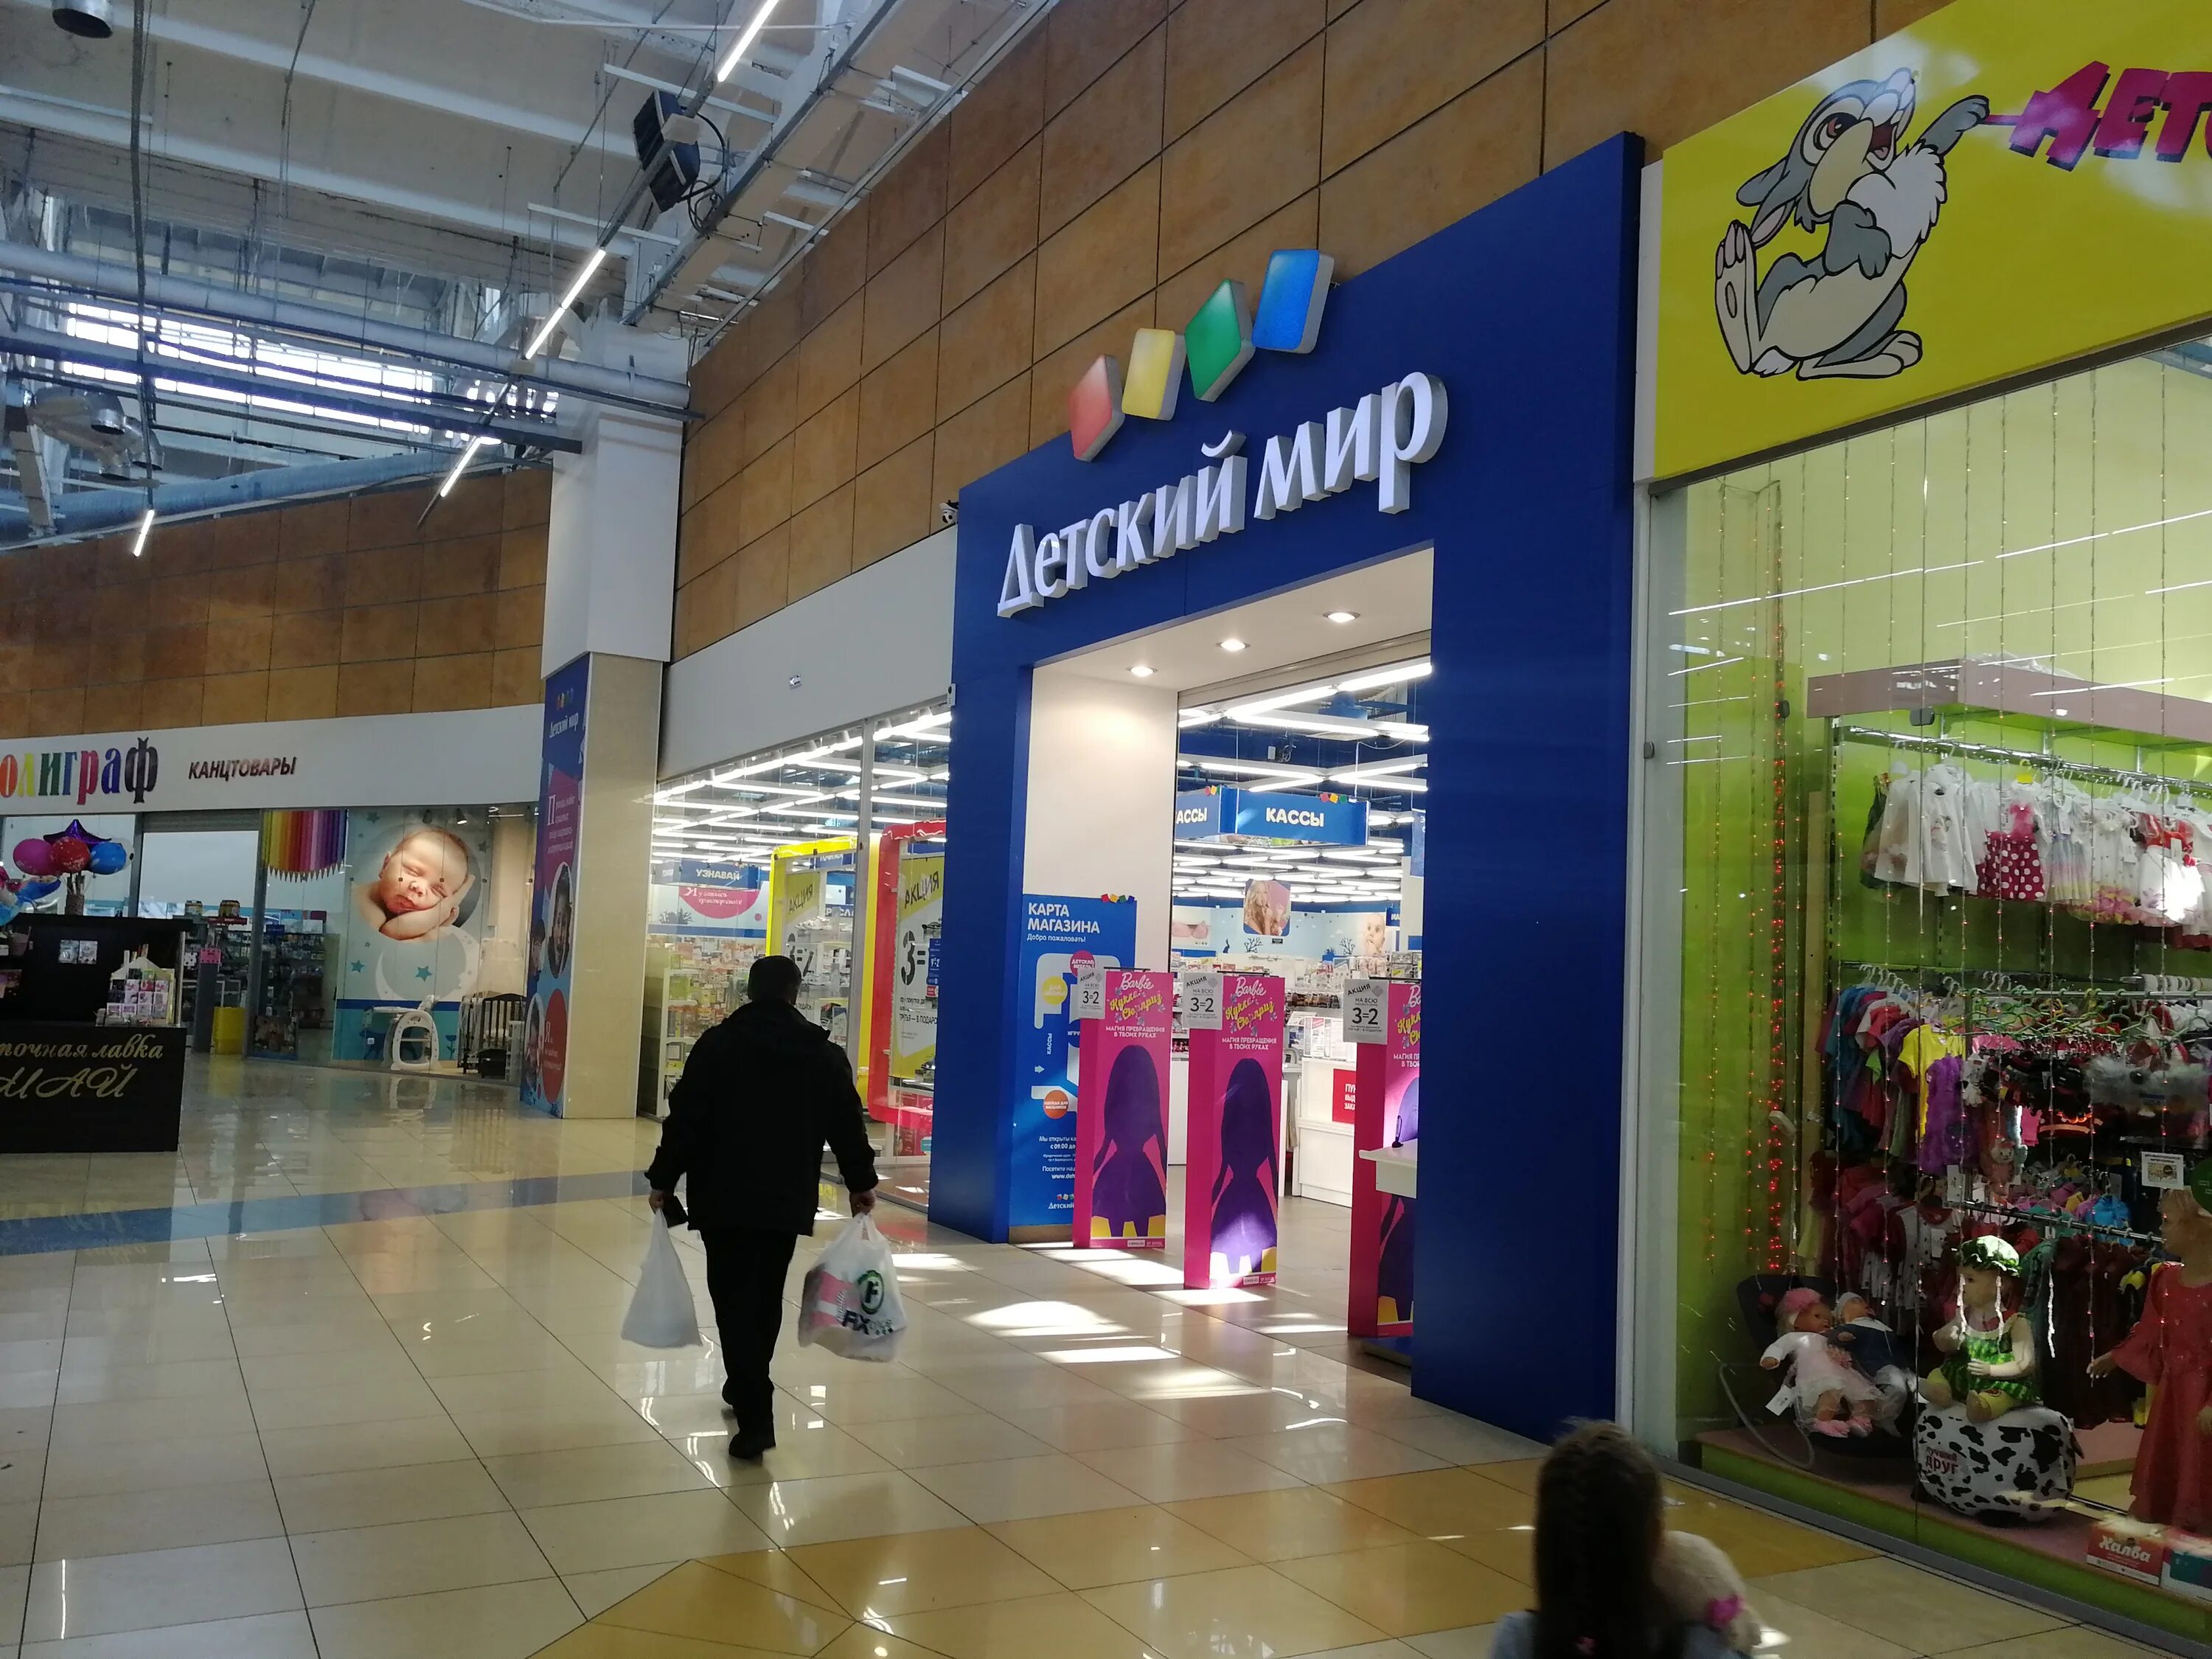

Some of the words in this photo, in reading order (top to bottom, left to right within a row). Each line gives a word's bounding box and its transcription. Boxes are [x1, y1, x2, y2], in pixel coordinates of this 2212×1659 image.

[2008, 60, 2212, 172] ДЕТ
[998, 430, 1248, 618] Детский
[1253, 372, 1448, 520] мир
[0, 737, 158, 805] олиграф
[189, 757, 296, 782] КАНЦТОВАРЫ
[1175, 807, 1208, 825] АССЫ
[1266, 807, 1324, 827] КАССЫ
[696, 869, 741, 880] УЗНАВАЙ
[788, 883, 813, 914] АКЦИЯ
[905, 871, 939, 909] АКЦИЯ
[1028, 902, 1069, 917] КАРТА
[1028, 918, 1100, 933] МАГАЗИНА
[1026, 933, 1047, 942] Добро
[1121, 973, 1154, 990] Barbie
[1186, 976, 1207, 987] АКЦИЯ
[1235, 977, 1266, 997] Barbie
[1347, 984, 1371, 995] АКЦИЯ
[1082, 991, 1099, 1004] 3=2
[1190, 998, 1214, 1012] 3=2
[1352, 1007, 1379, 1025] 3=2
[92, 1034, 163, 1058] лавка
[1925, 1455, 1958, 1474] друг
